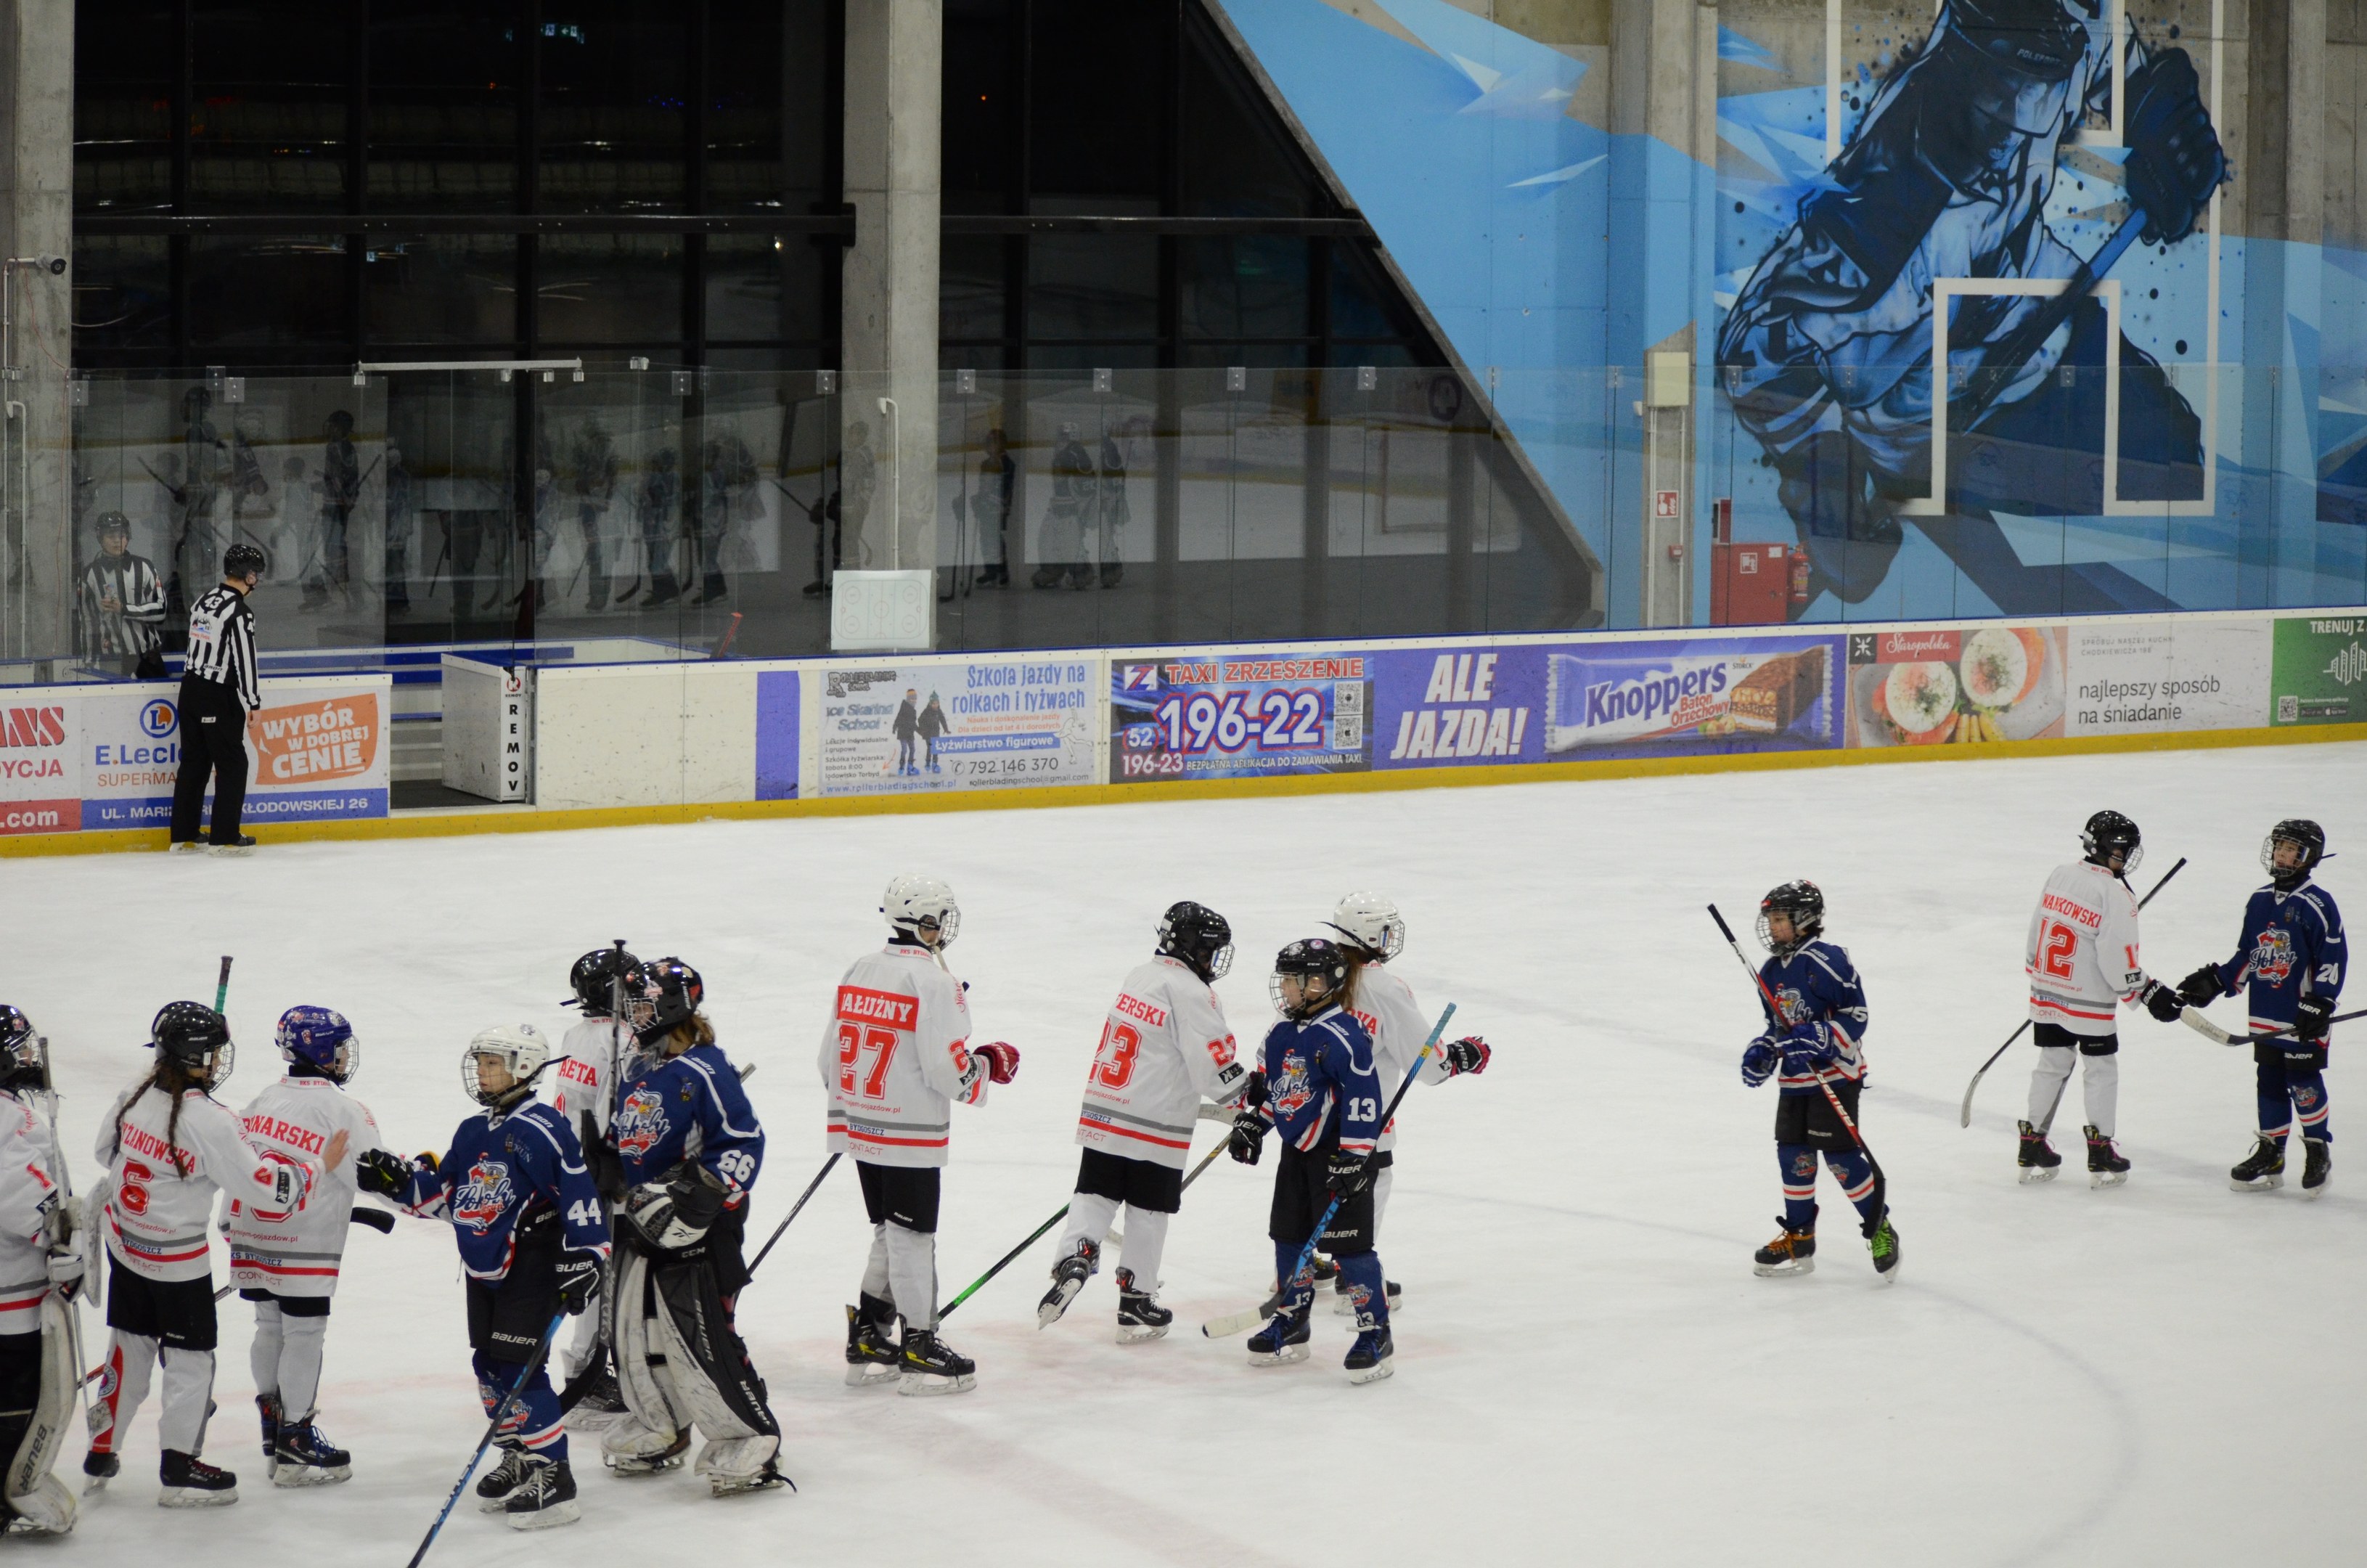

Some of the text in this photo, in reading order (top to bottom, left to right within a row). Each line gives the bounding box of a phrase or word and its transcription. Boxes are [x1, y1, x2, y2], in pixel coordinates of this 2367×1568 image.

[204, 596, 224, 609] 43
[2310, 620, 2364, 636] TRENUJ Z
[1886, 632, 1952, 658] Staropolska
[967, 663, 1085, 688] Szkoła jazdy na
[1165, 658, 1363, 685] TAXI ZRZESZENIE
[1424, 654, 1498, 703] ALE
[952, 692, 1010, 714] rolkach
[1024, 688, 1085, 713] łyżwach
[1585, 662, 1727, 728] Knoppers
[2080, 675, 2220, 703] najlepszy sposób
[1672, 701, 1730, 727] Orzechowy
[1680, 694, 1712, 712] Baton
[2078, 703, 2182, 724] na śniadanie
[262, 702, 353, 740] WYBÓR
[1158, 689, 1323, 752] 196-22
[287, 726, 368, 751] W DOBREJ
[935, 735, 1054, 752] Łyżwiarstwo figurowe
[1122, 727, 1159, 751] (52)
[1390, 707, 1529, 760] JAZDA!
[96, 743, 181, 765] E.Lecl
[272, 741, 362, 779] CENIE
[970, 757, 1059, 774] 792 146 370
[1123, 754, 1183, 775] 196-23
[1277, 756, 1290, 767] DO
[1291, 755, 1343, 766] ZAMAWIANIA
[0, 759, 63, 779] YCJA
[98, 772, 176, 786] SUPERMA
[102, 809, 126, 820] UL.
[348, 798, 368, 809] 26
[2034, 916, 2079, 981] 12
[841, 993, 912, 1023] AŁUŻNY
[2298, 1000, 2321, 1015] UER
[838, 1020, 899, 1100] 27
[948, 1038, 970, 1074] 2
[1348, 1097, 1376, 1122] 13
[1232, 1119, 1262, 1134] UER
[716, 1149, 755, 1183] 66
[1328, 1164, 1362, 1174] AUER
[119, 1157, 155, 1217] 6
[535, 1207, 560, 1224] BAU
[567, 1198, 602, 1227] 44
[682, 1246, 706, 1259] CCM
[1294, 1291, 1311, 1307] 13
[491, 1331, 537, 1347] BAUER
[18, 1424, 49, 1493] BAUER
